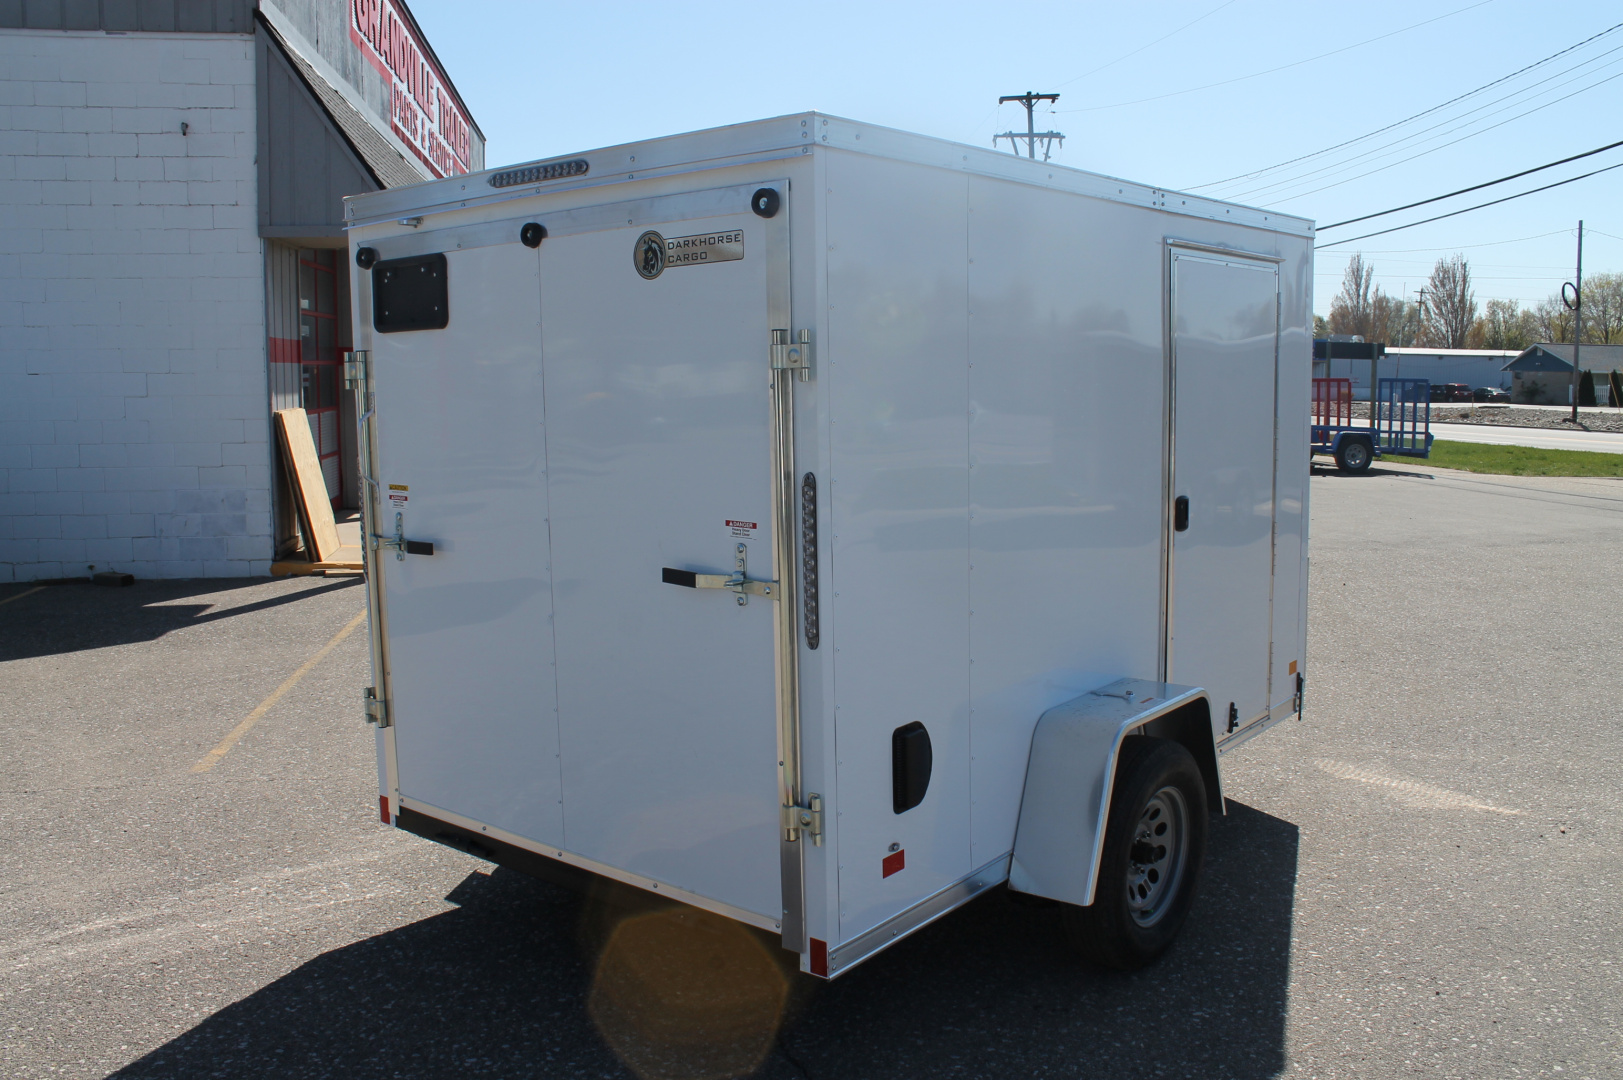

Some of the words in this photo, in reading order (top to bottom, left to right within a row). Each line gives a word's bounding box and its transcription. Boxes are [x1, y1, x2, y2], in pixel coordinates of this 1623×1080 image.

[394, 82, 418, 142] PARTS
[422, 117, 426, 150] &
[429, 127, 453, 177] SERVICE
[437, 87, 470, 170] TRAILER
[667, 233, 741, 250] DARKHORSE
[667, 251, 708, 264] CARGO
